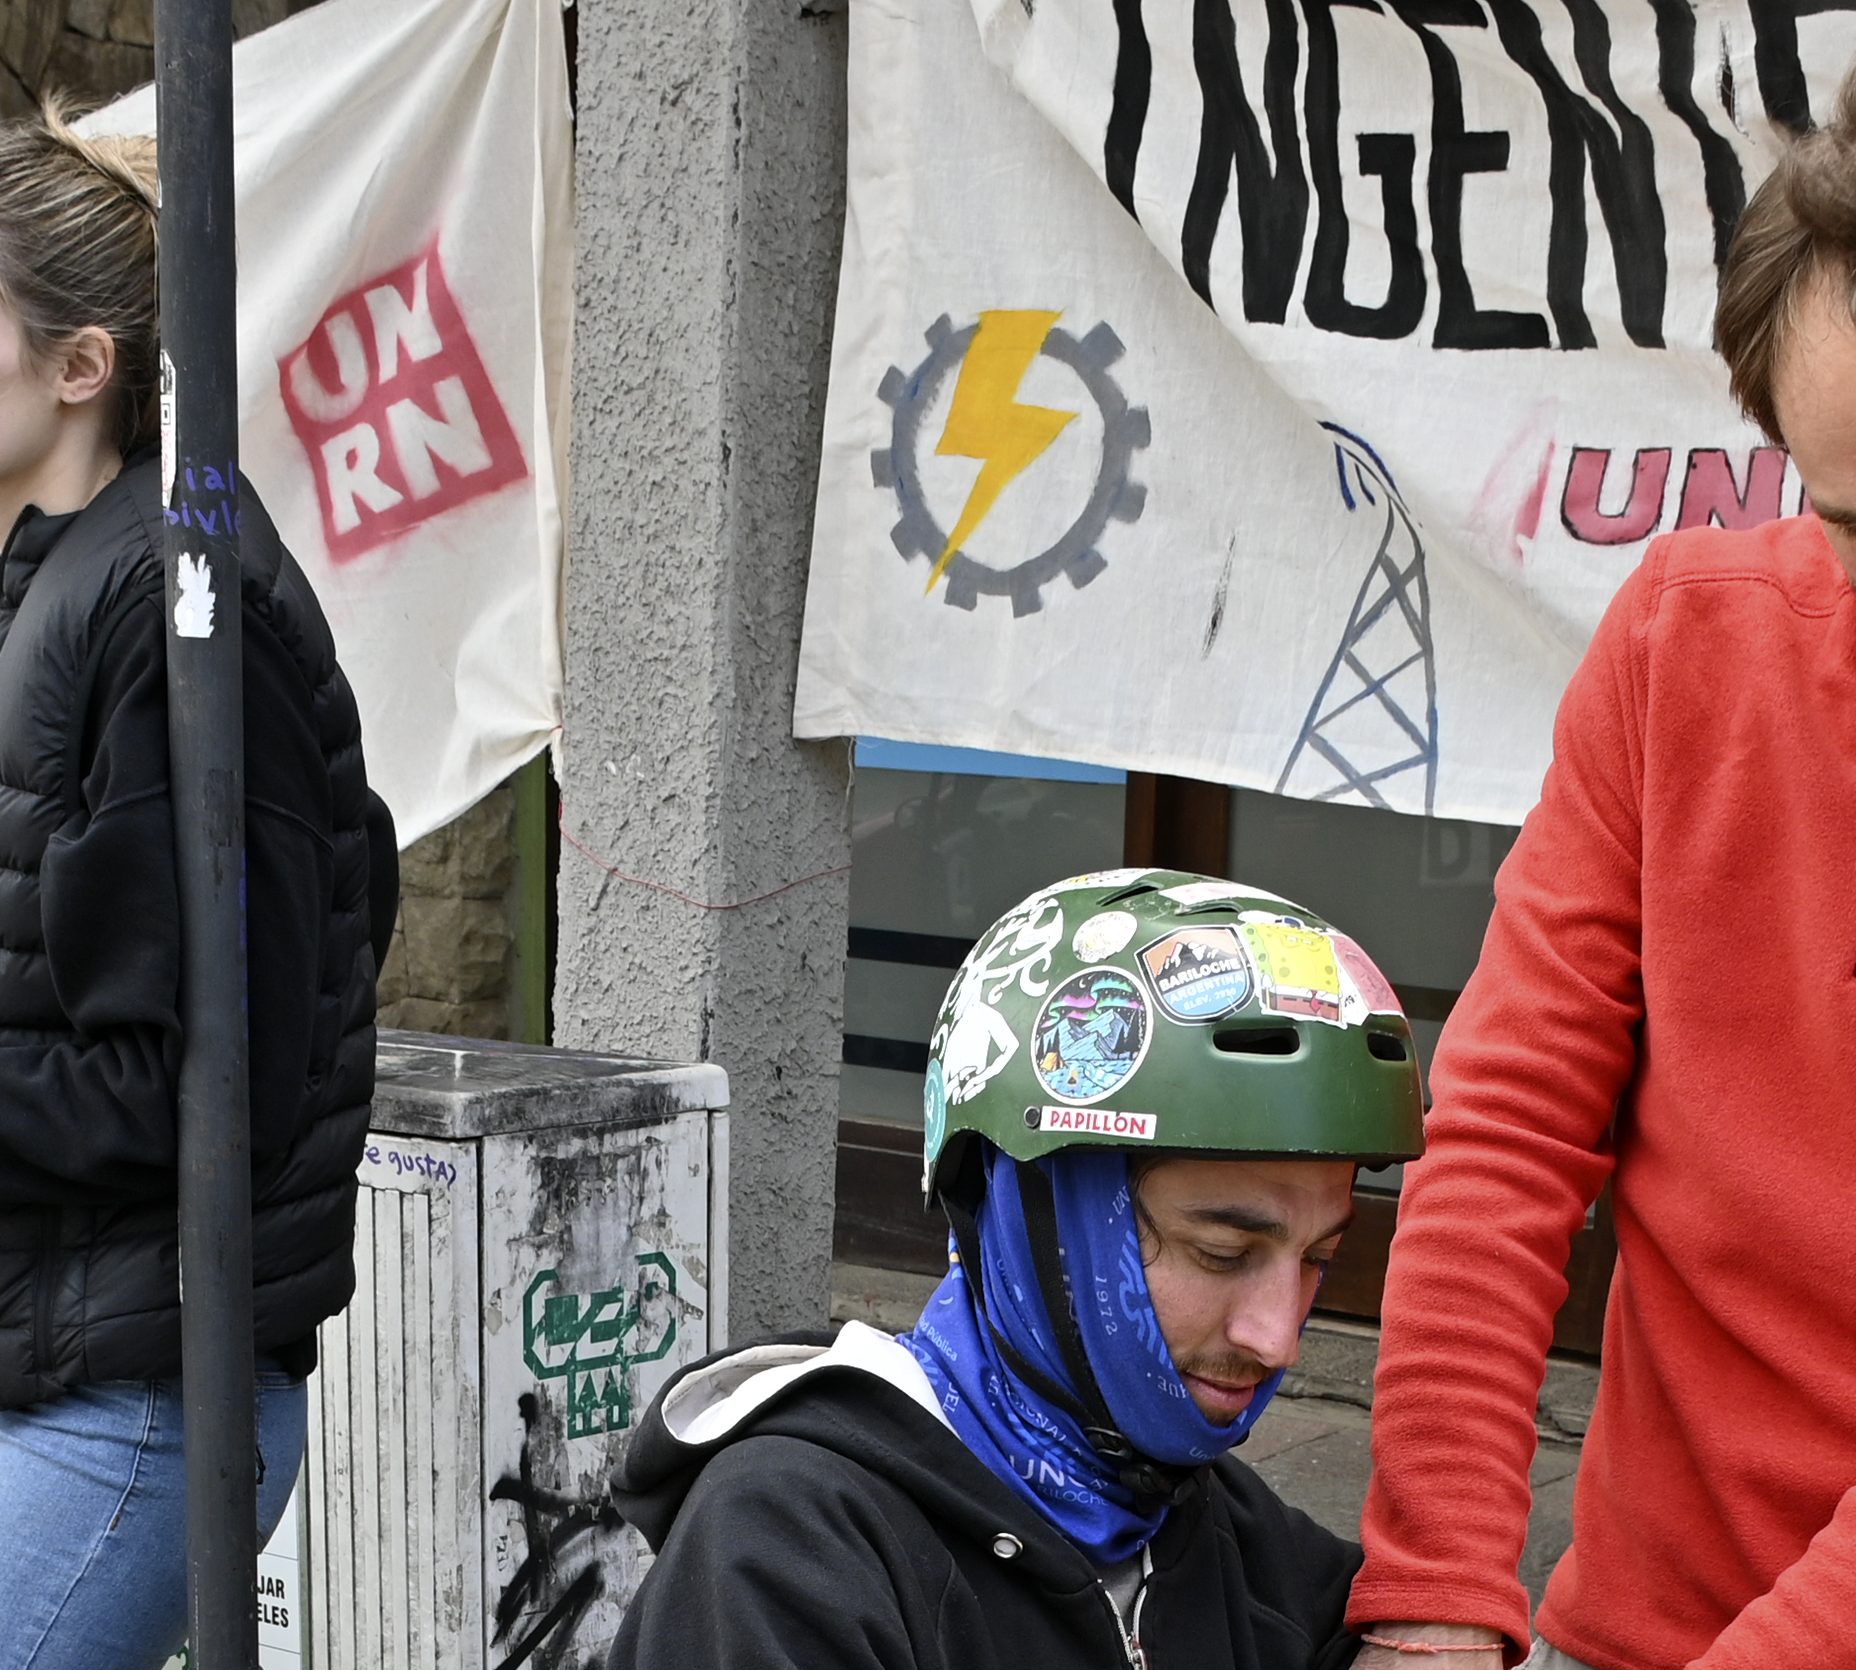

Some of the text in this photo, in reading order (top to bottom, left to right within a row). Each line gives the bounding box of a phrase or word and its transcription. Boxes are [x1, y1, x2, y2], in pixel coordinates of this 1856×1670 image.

[289, 256, 445, 424] UN
[319, 374, 493, 537] RN
[1560, 446, 1816, 546] UN
